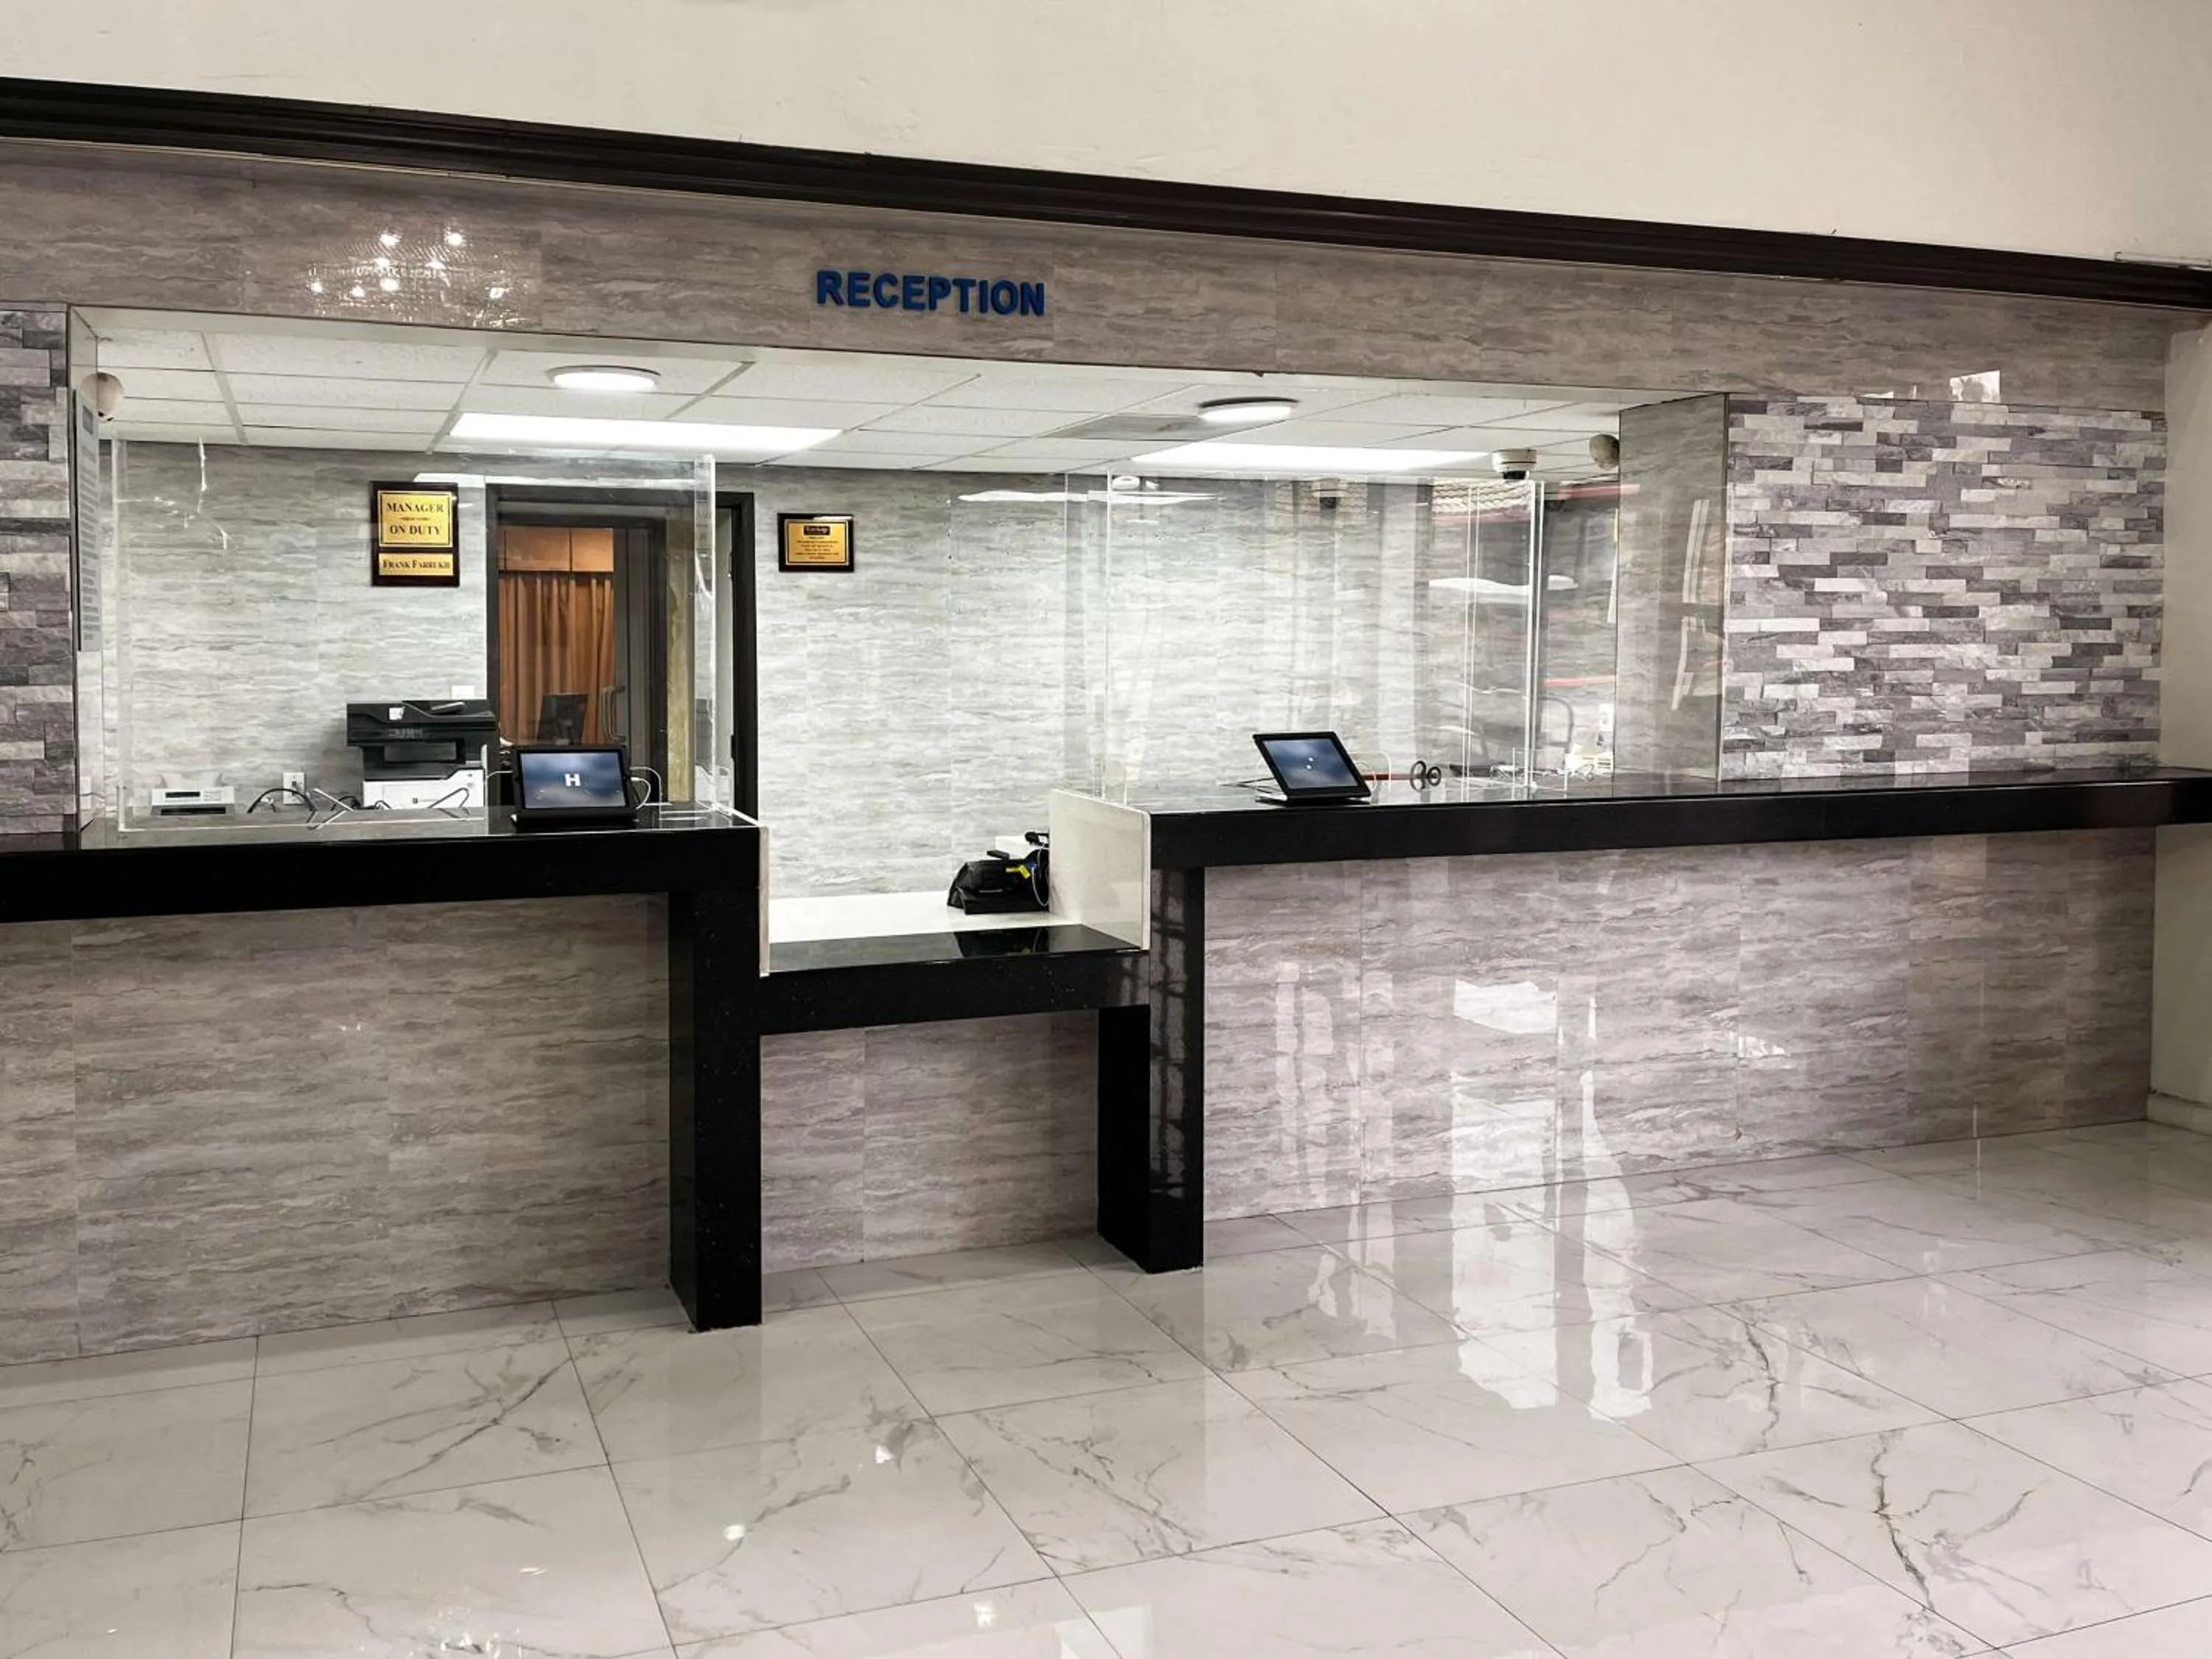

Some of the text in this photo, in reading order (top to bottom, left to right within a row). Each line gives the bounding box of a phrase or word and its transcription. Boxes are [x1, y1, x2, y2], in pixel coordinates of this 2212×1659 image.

[815, 269, 1045, 316] RECEPTION
[386, 502, 443, 512] MANAGER
[389, 524, 441, 535] ON DUTY
[383, 559, 411, 568] FRANK
